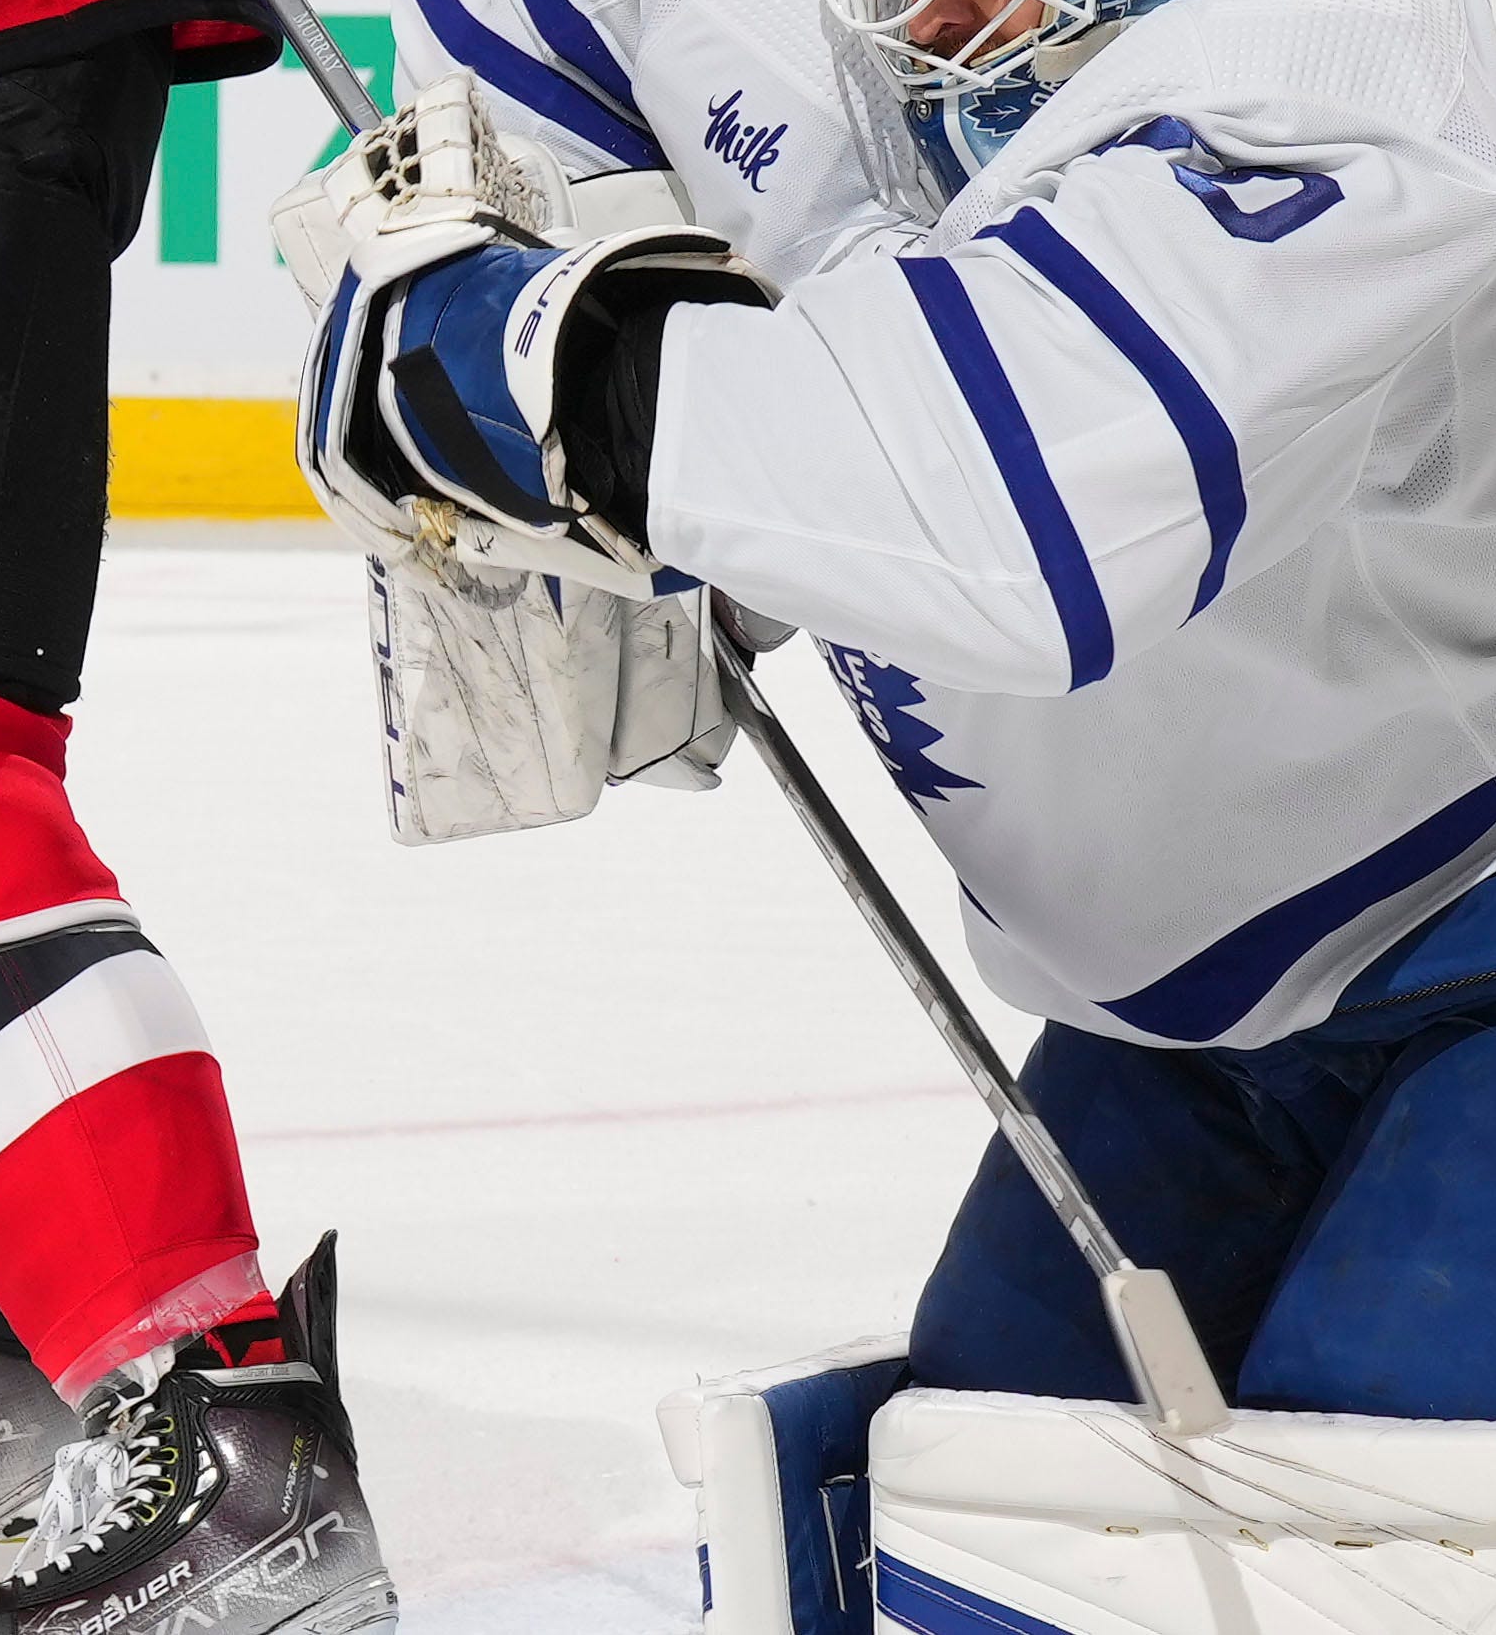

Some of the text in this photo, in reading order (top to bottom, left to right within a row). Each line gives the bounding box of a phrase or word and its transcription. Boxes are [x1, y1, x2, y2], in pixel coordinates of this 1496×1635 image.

[292, 10, 345, 73] MURRAY
[280, 1434, 306, 1515] HYPERLITE
[78, 1559, 194, 1635] BAUER
